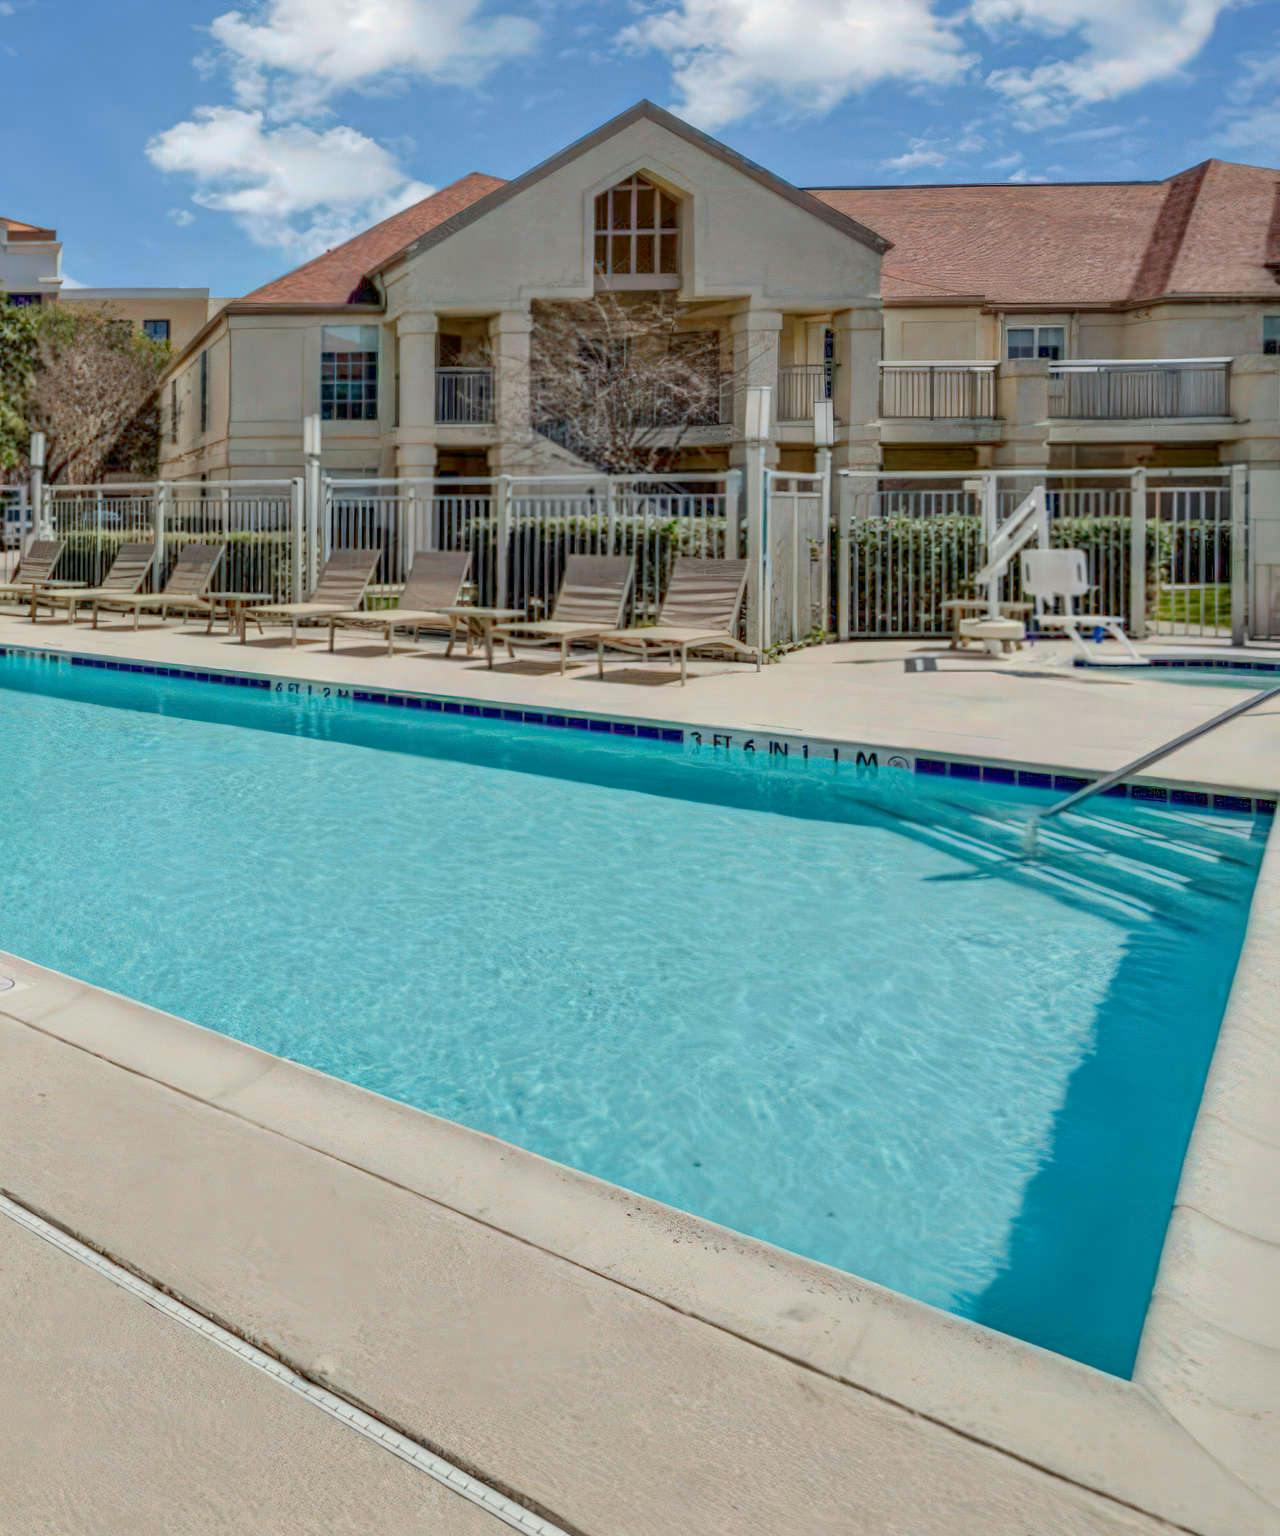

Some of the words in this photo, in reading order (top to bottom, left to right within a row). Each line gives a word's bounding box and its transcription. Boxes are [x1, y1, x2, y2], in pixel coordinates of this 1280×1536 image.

[713, 733, 733, 749] FT
[769, 741, 788, 756] IN
[856, 751, 878, 768] M
